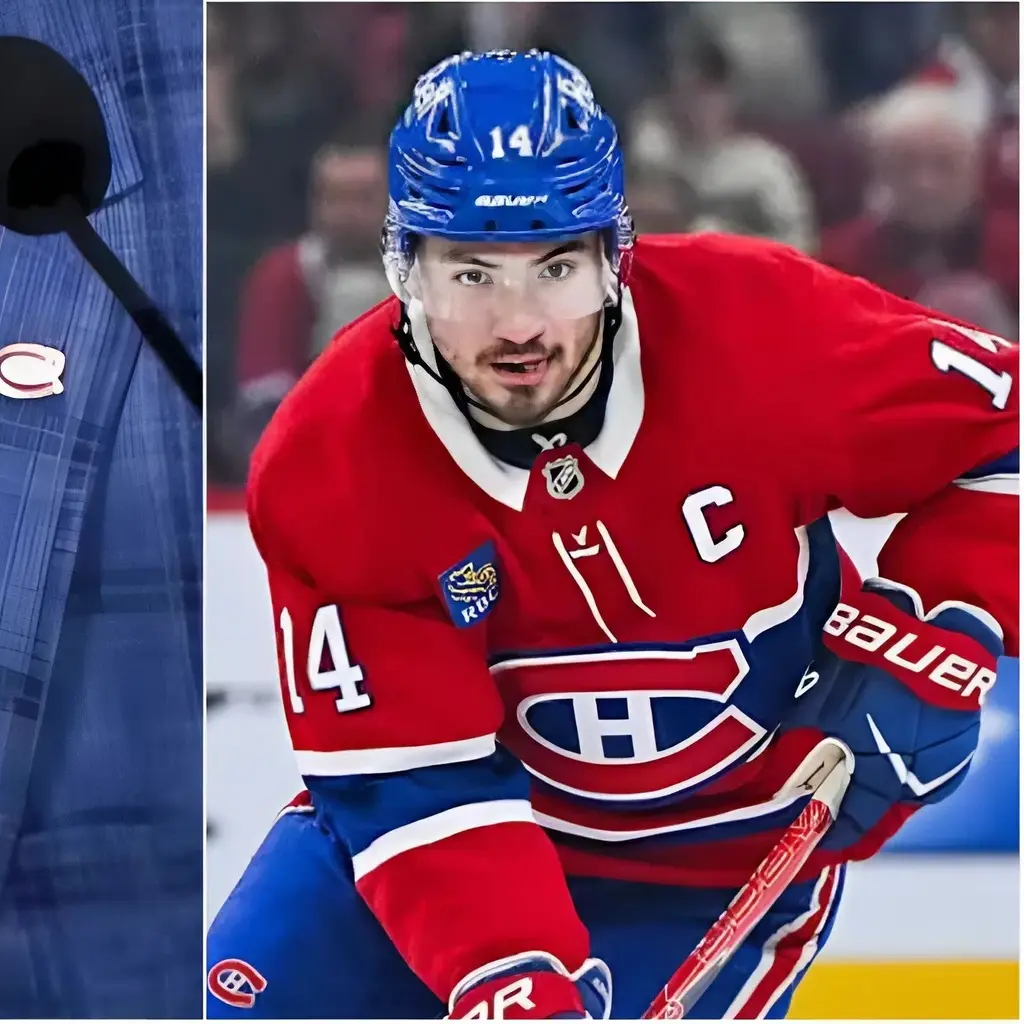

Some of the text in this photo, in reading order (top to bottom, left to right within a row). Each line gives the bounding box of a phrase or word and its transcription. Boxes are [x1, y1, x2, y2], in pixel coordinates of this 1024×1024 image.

[489, 125, 533, 158] 14
[682, 485, 744, 563] C
[280, 604, 372, 714] 14
